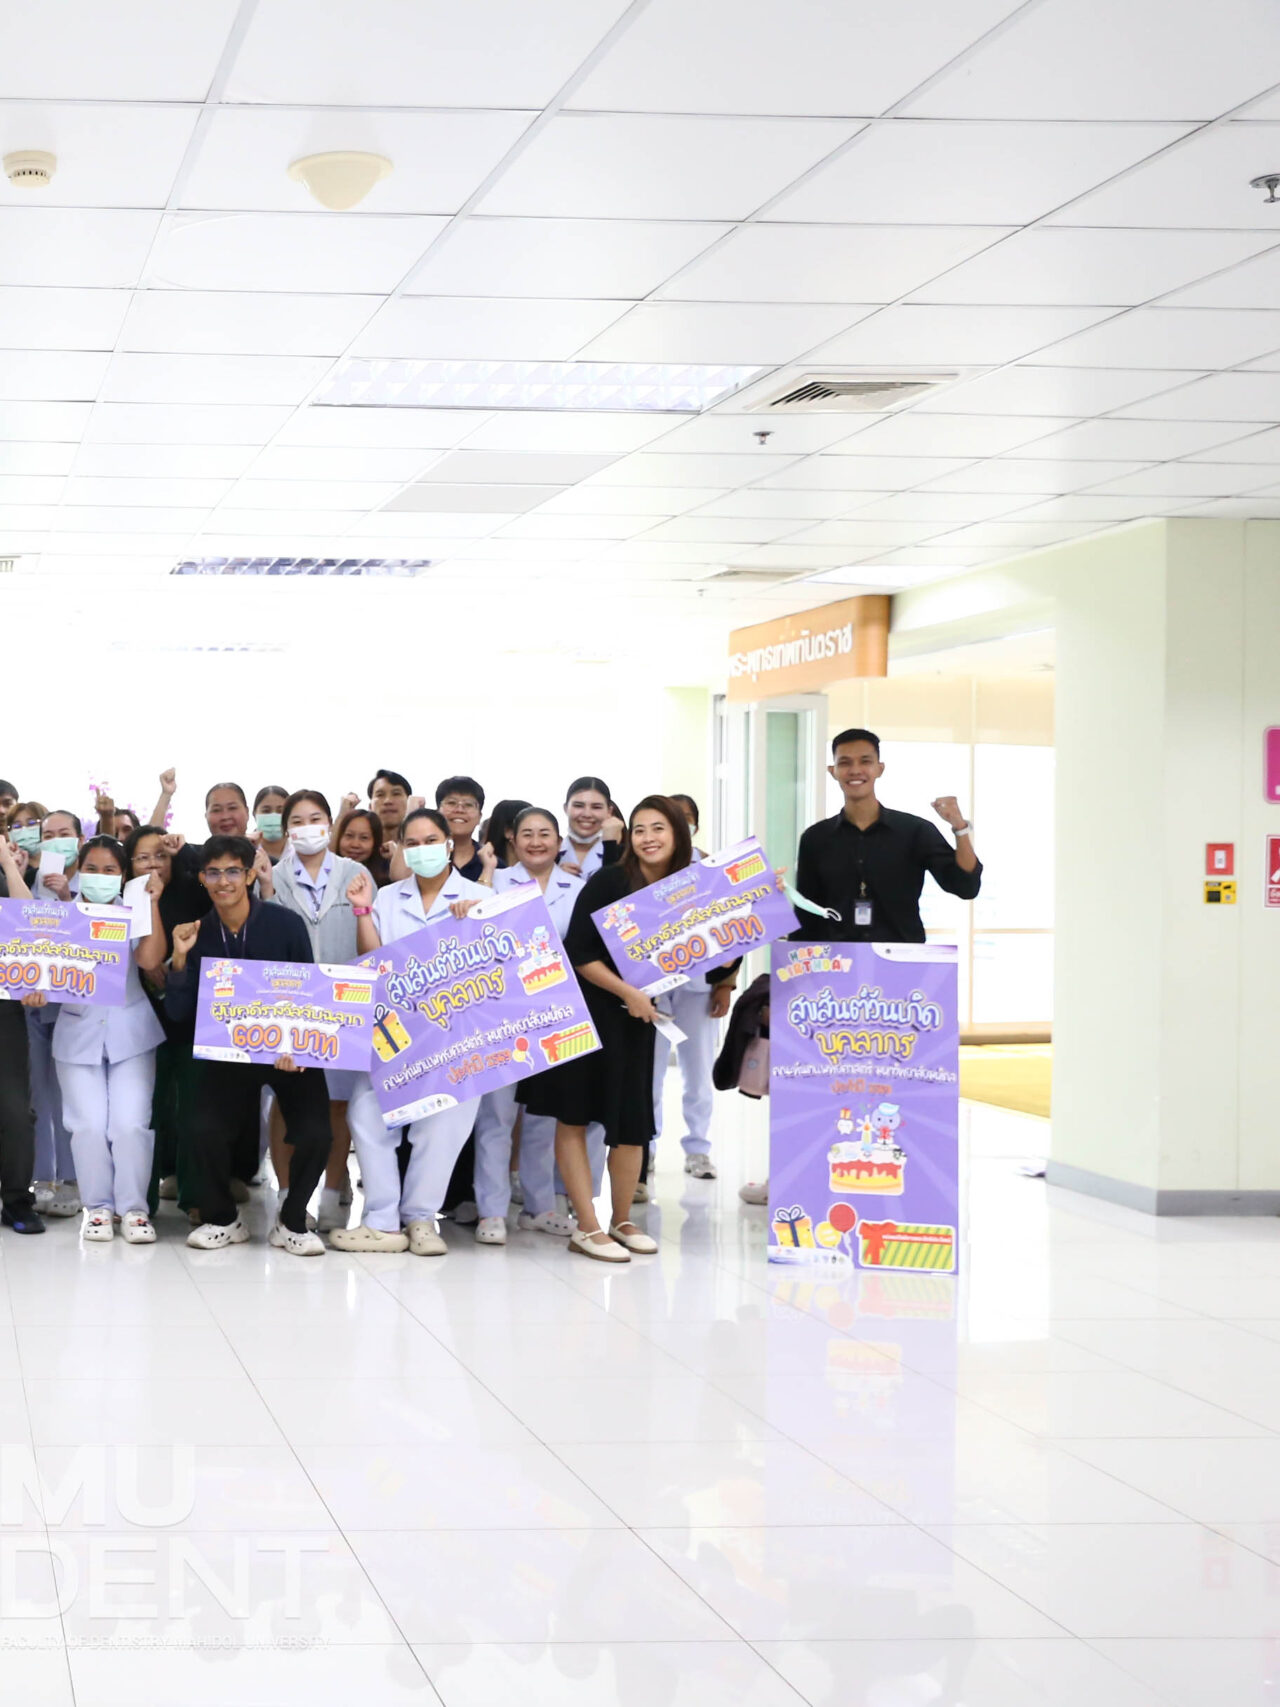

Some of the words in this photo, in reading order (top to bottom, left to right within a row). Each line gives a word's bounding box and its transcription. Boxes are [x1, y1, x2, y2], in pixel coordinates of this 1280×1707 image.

[625, 885, 773, 961] ผู้โชคดีรางวัลจับฉลาก
[657, 935, 708, 974] 600
[710, 914, 764, 948] บาท
[789, 945, 830, 961] HAPPY
[49, 964, 96, 997] บาท
[386, 924, 515, 1012] สุขสันต์วันเกิด
[777, 954, 853, 981] BIRTHDAY
[211, 1000, 366, 1027] ผู้โชคดีรางวัลจับฉลาก
[419, 967, 504, 1030] บุคลากร
[789, 985, 942, 1038] สุขสันต์วันเกิด
[233, 1024, 282, 1049] 600
[291, 1027, 338, 1059] บาท
[816, 1030, 917, 1064] บุคลากร
